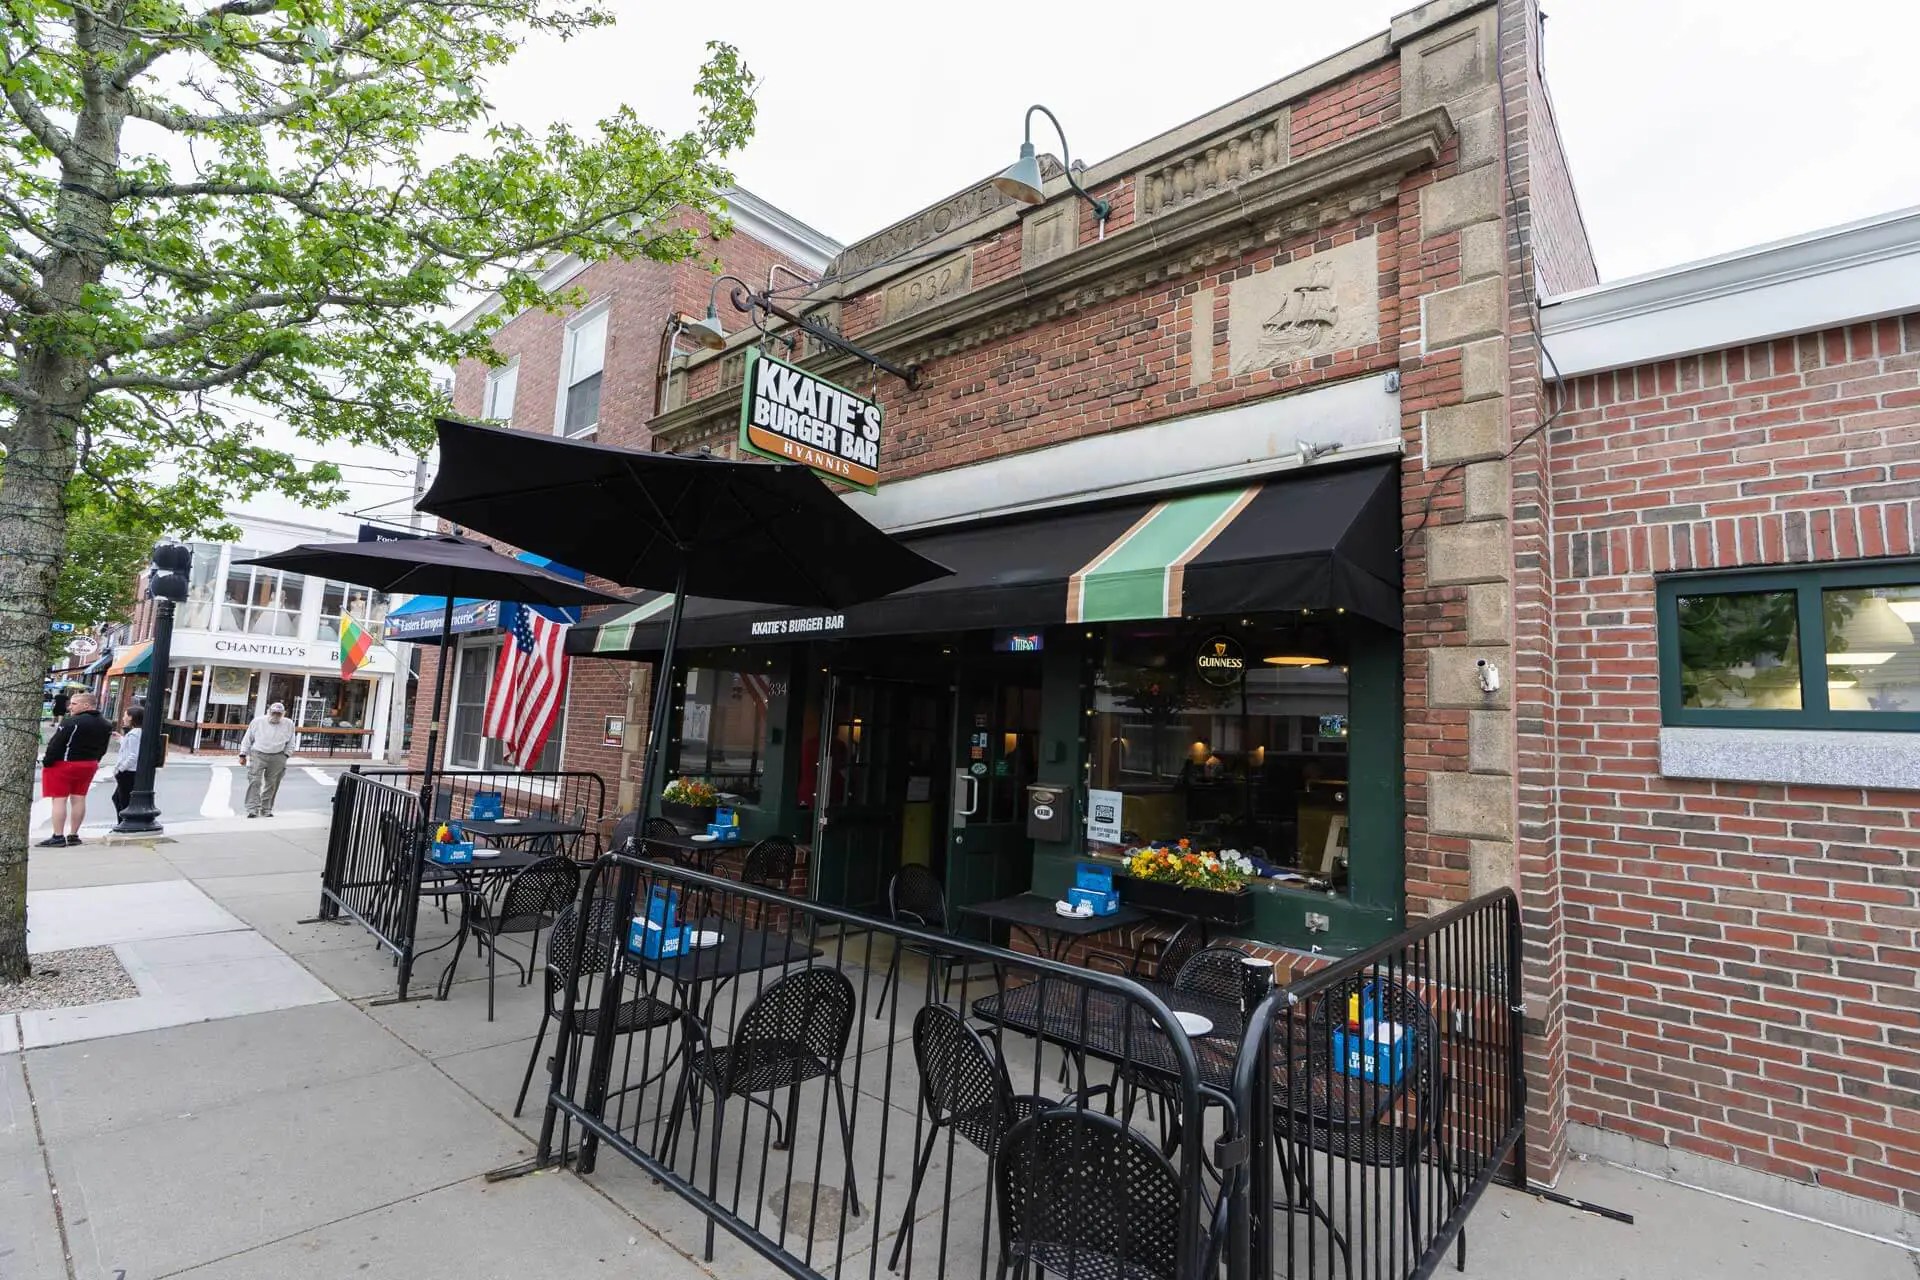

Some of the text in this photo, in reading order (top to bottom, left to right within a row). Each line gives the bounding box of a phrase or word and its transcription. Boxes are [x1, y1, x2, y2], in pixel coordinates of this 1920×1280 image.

[757, 357, 881, 442] KKATIE'S
[754, 396, 878, 468] BURGER BAR
[783, 441, 850, 475] HYANNIS
[451, 610, 474, 626] roceries
[751, 614, 845, 635] KKATIE'S BURGER BAR
[215, 640, 306, 657] CHANTILLY'S
[1198, 655, 1243, 668] GUINNESS
